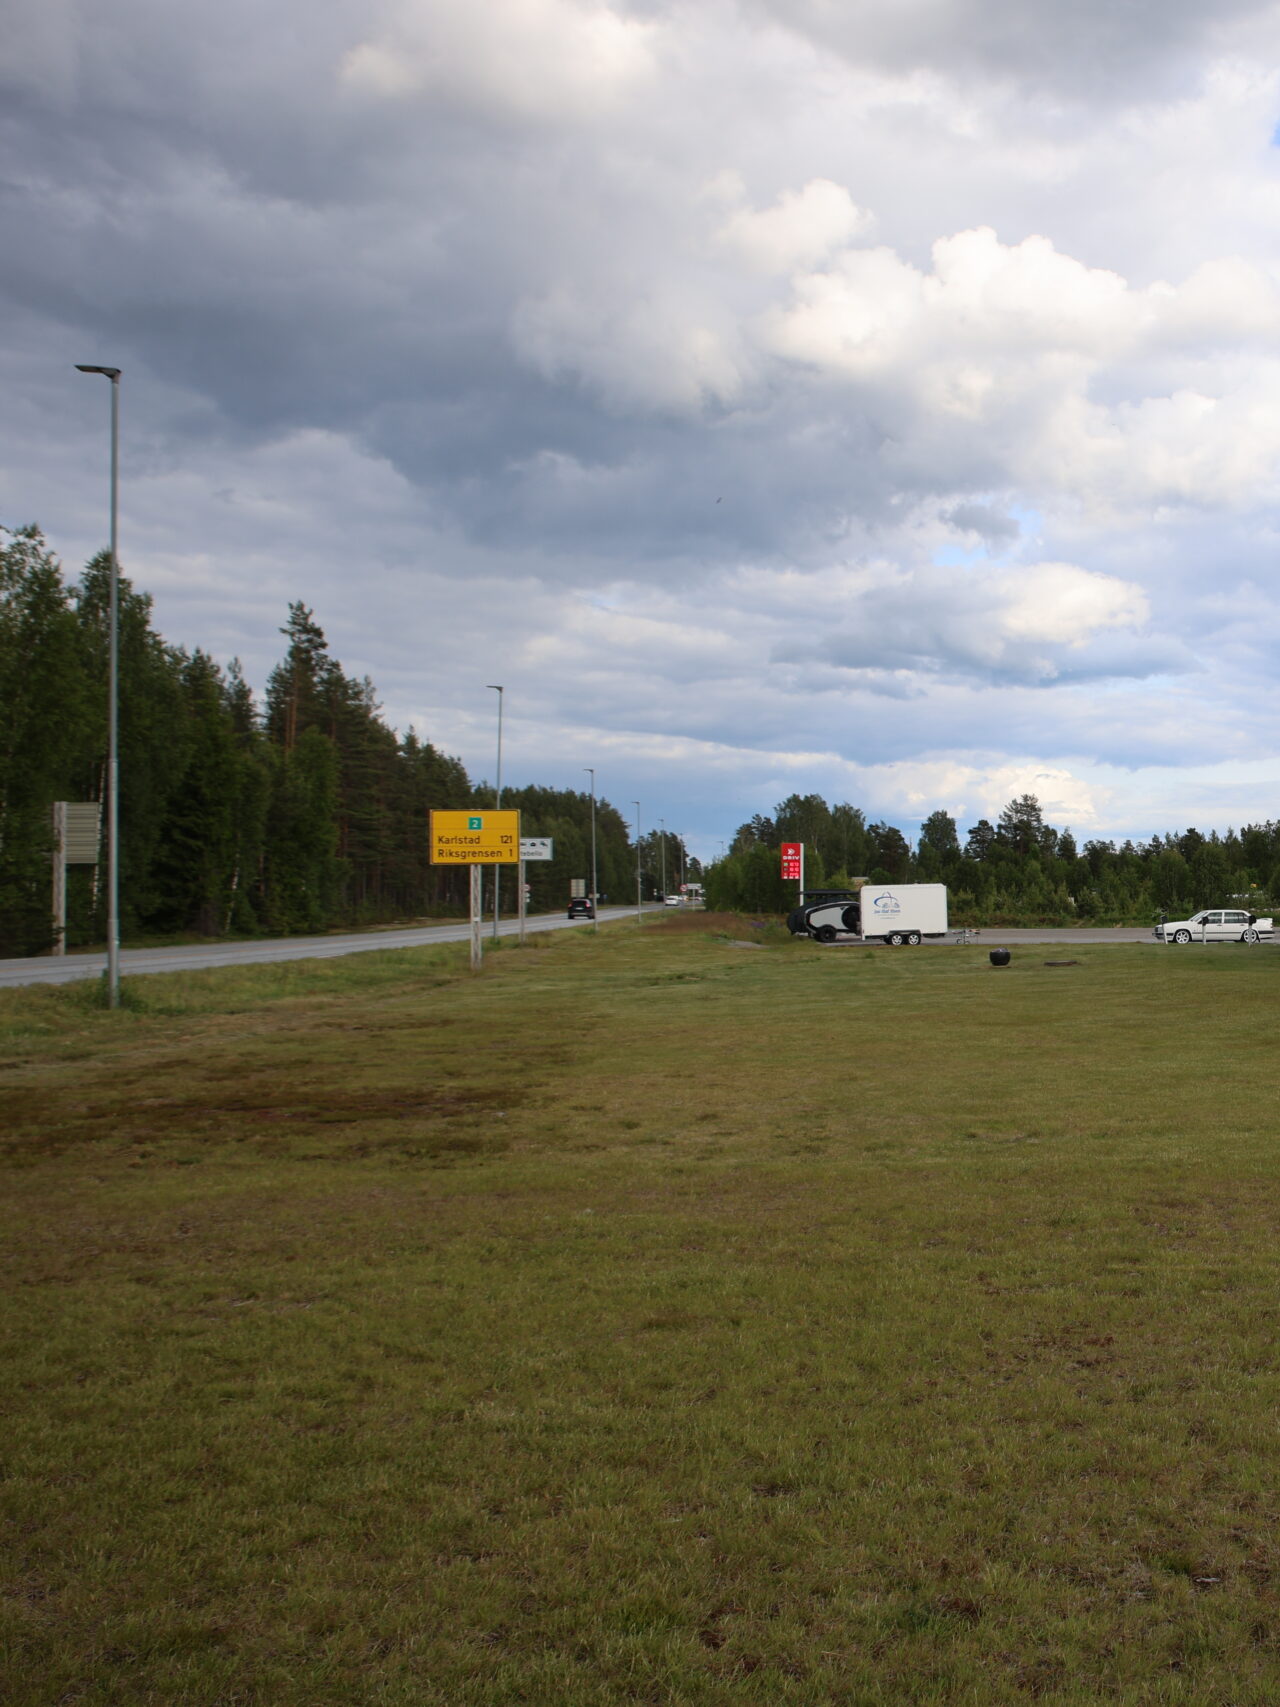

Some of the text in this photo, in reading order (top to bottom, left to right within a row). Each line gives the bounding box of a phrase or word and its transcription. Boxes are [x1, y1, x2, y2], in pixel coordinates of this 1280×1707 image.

[438, 835, 513, 845] Karlstad 121
[438, 849, 502, 859] Riksgrensen
